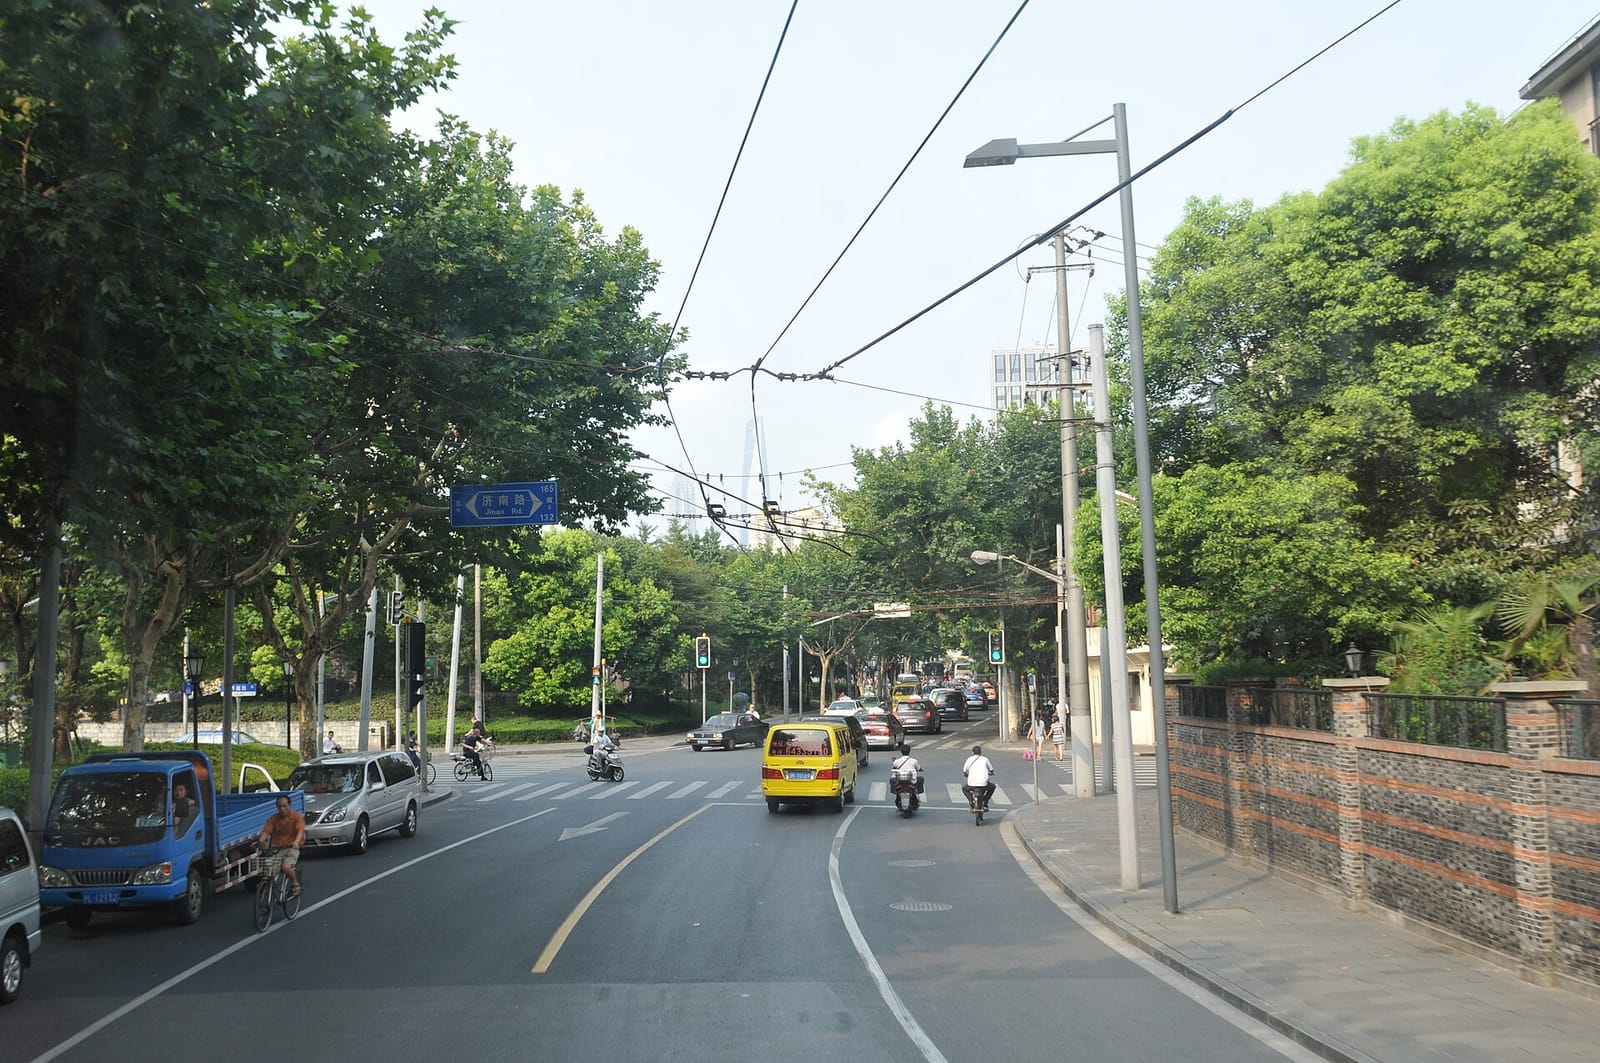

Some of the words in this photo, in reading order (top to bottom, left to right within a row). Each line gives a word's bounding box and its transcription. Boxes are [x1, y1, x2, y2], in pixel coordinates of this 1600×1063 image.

[540, 485, 554, 493] 165
[482, 494, 526, 507] 济南路
[540, 513, 554, 521] 132
[82, 836, 119, 846] JAC
